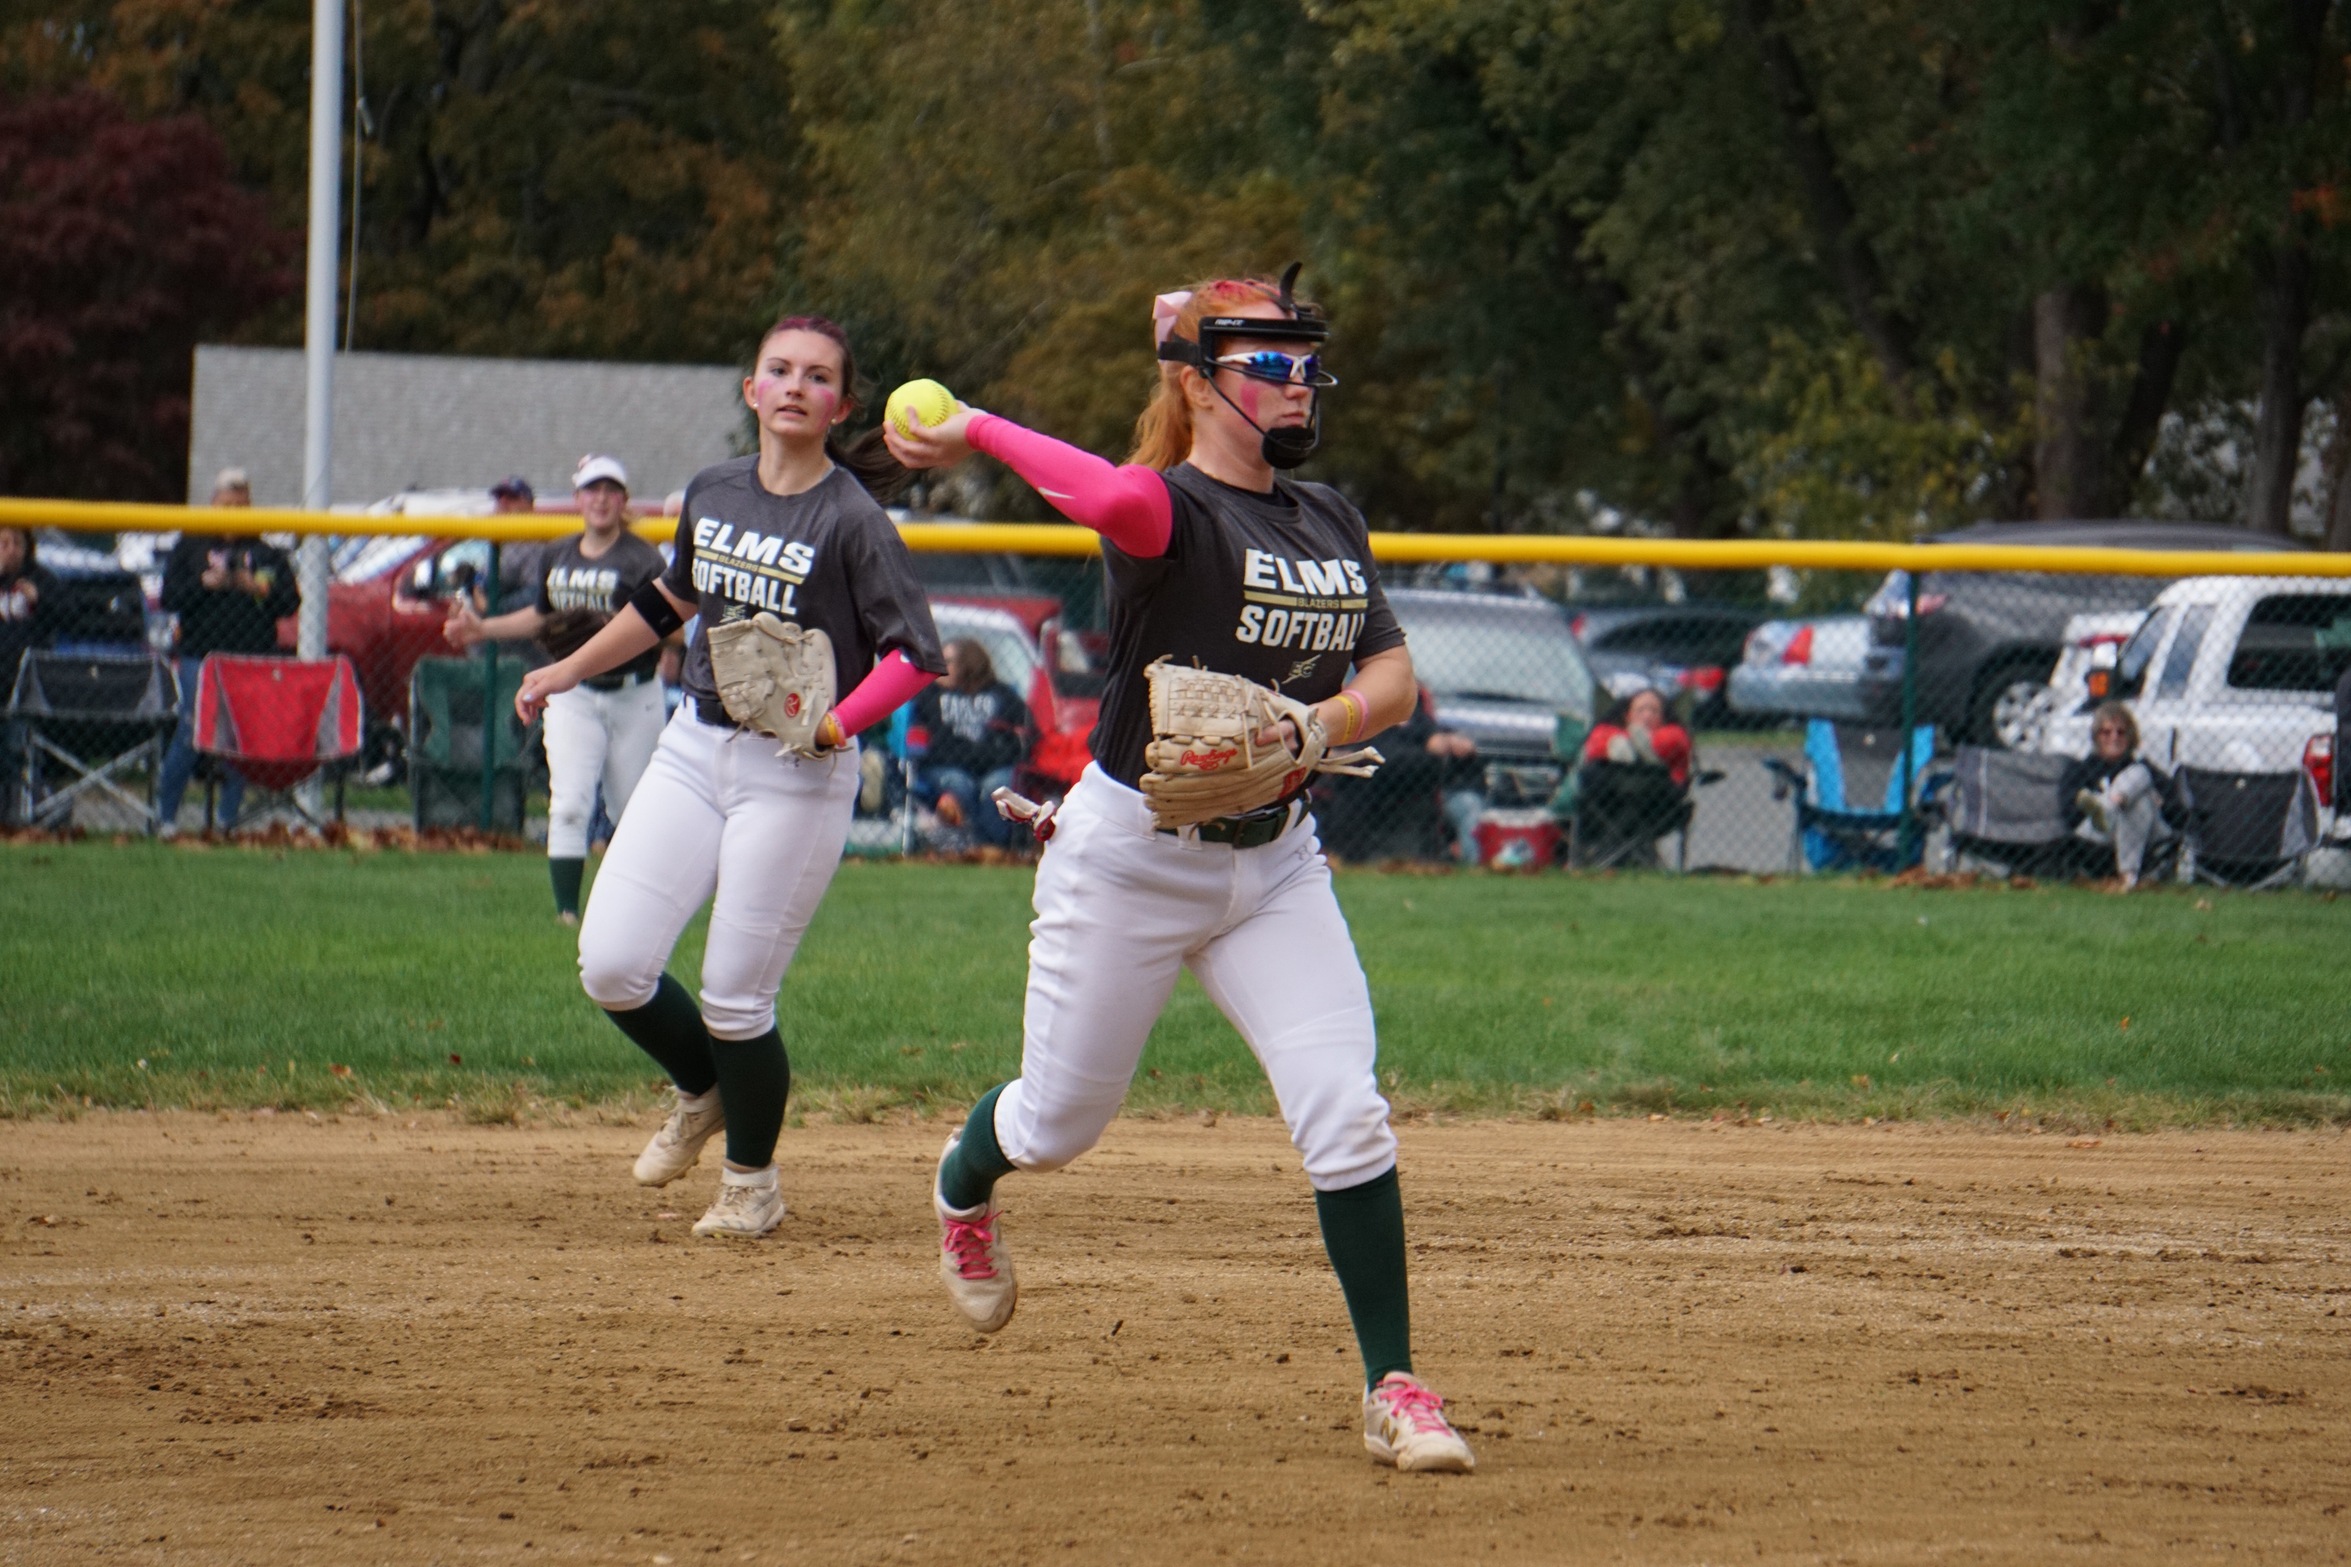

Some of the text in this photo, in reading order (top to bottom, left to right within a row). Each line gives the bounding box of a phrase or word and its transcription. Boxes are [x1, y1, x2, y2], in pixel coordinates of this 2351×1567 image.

[693, 516, 816, 575] ELMS
[719, 553, 760, 573] BLAZERS
[692, 557, 798, 616] SOFTBALL
[1243, 548, 1368, 596] ELMS
[1297, 597, 1340, 609] BLAZERS
